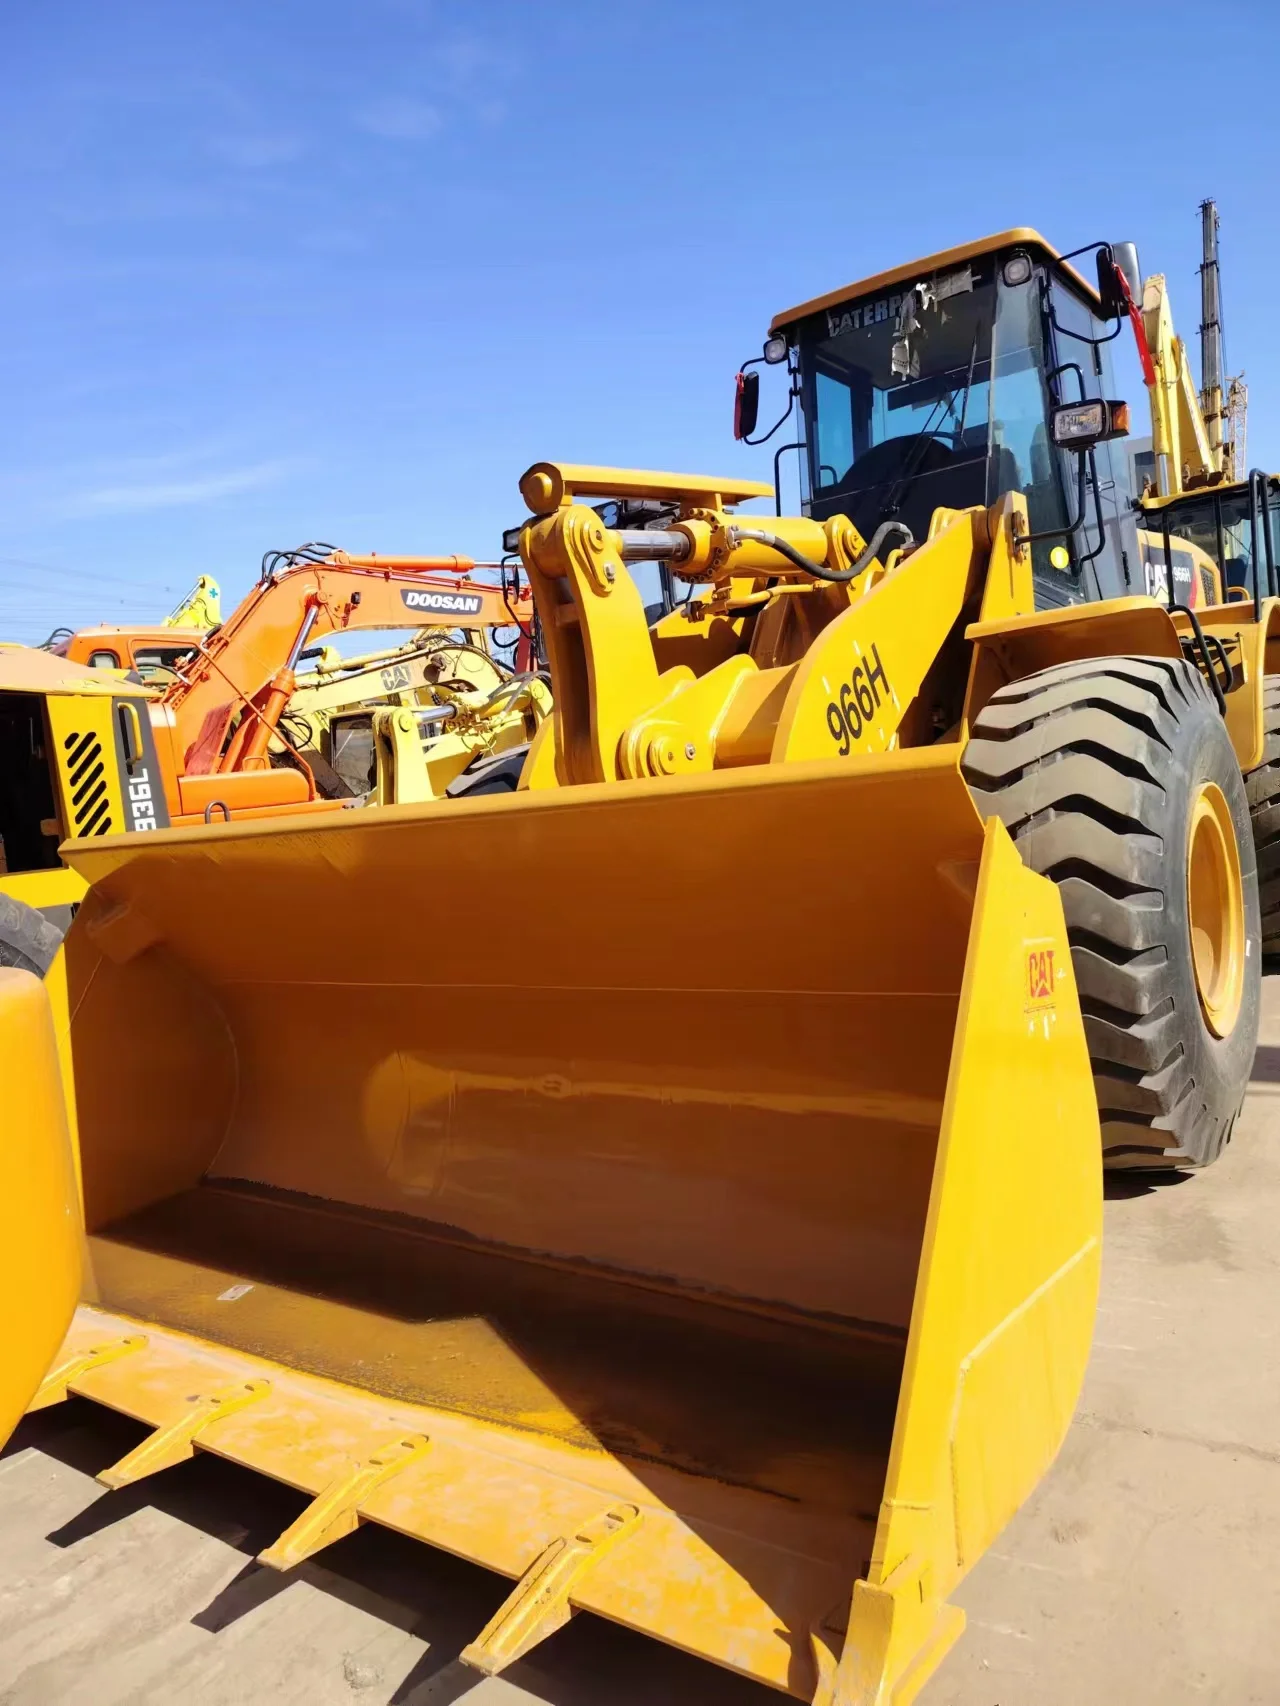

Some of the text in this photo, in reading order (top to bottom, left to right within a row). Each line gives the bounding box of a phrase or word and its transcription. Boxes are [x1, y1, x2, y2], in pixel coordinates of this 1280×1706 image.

[828, 291, 909, 337] CATERP
[405, 592, 479, 612] DOOSAN
[380, 665, 411, 691] CAT
[827, 642, 890, 756] 966H
[1029, 950, 1054, 998] CAT
